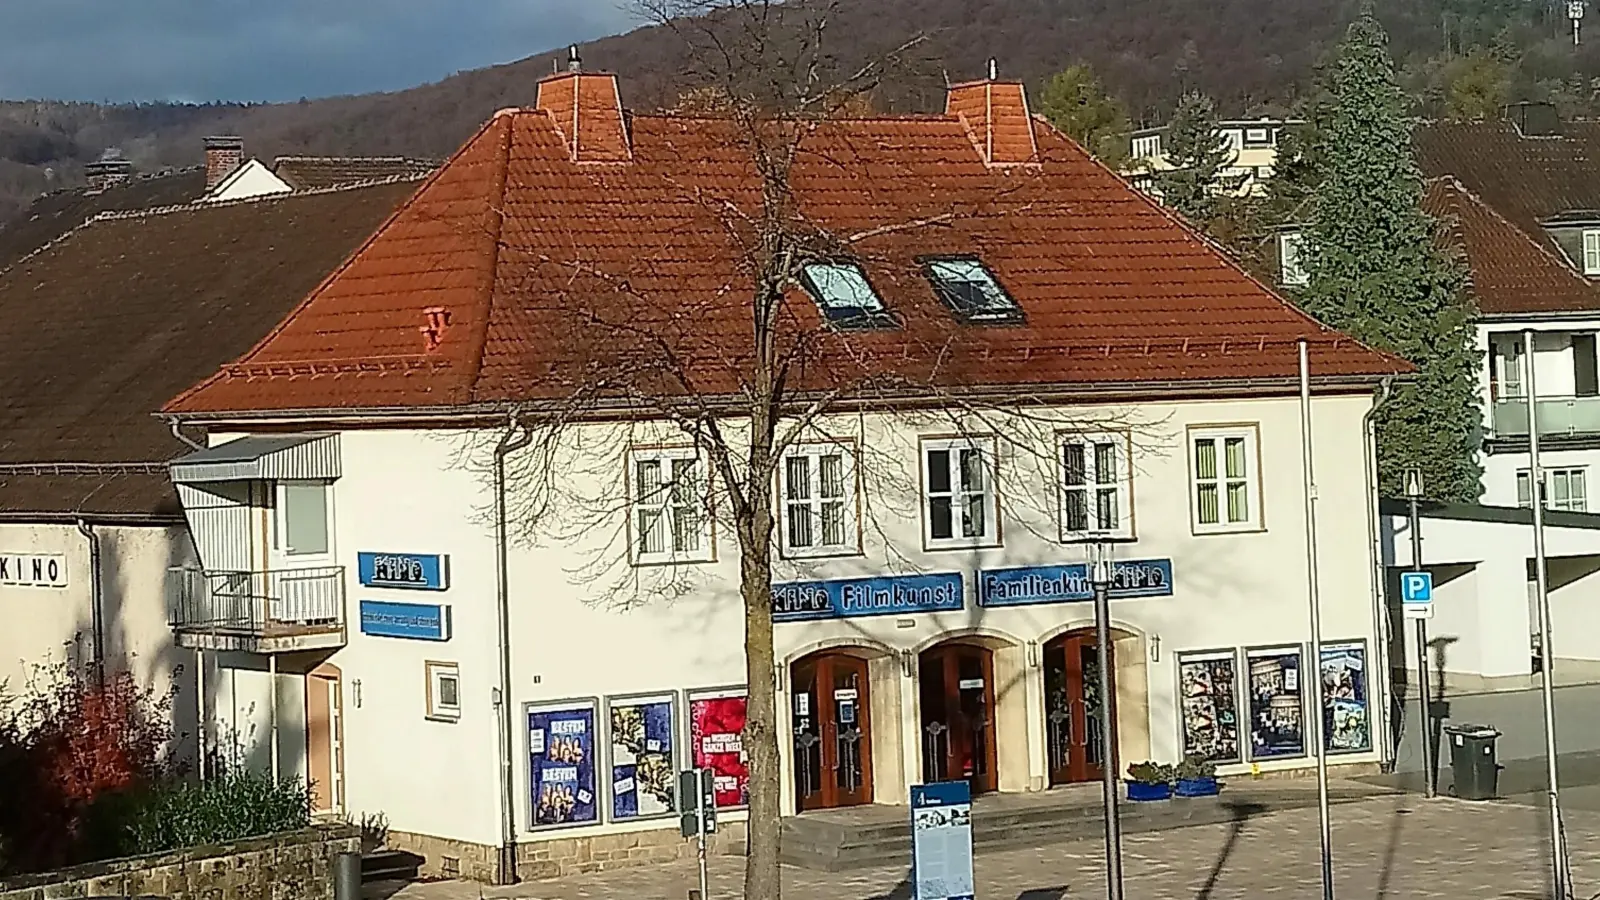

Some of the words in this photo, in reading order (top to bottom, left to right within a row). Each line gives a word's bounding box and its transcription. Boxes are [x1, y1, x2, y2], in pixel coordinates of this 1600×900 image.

[0, 557, 58, 582] KINO
[371, 555, 427, 584] KINO
[841, 581, 956, 610] Filmkunst
[985, 571, 1095, 599] Familienkin
[1408, 576, 1425, 599] P
